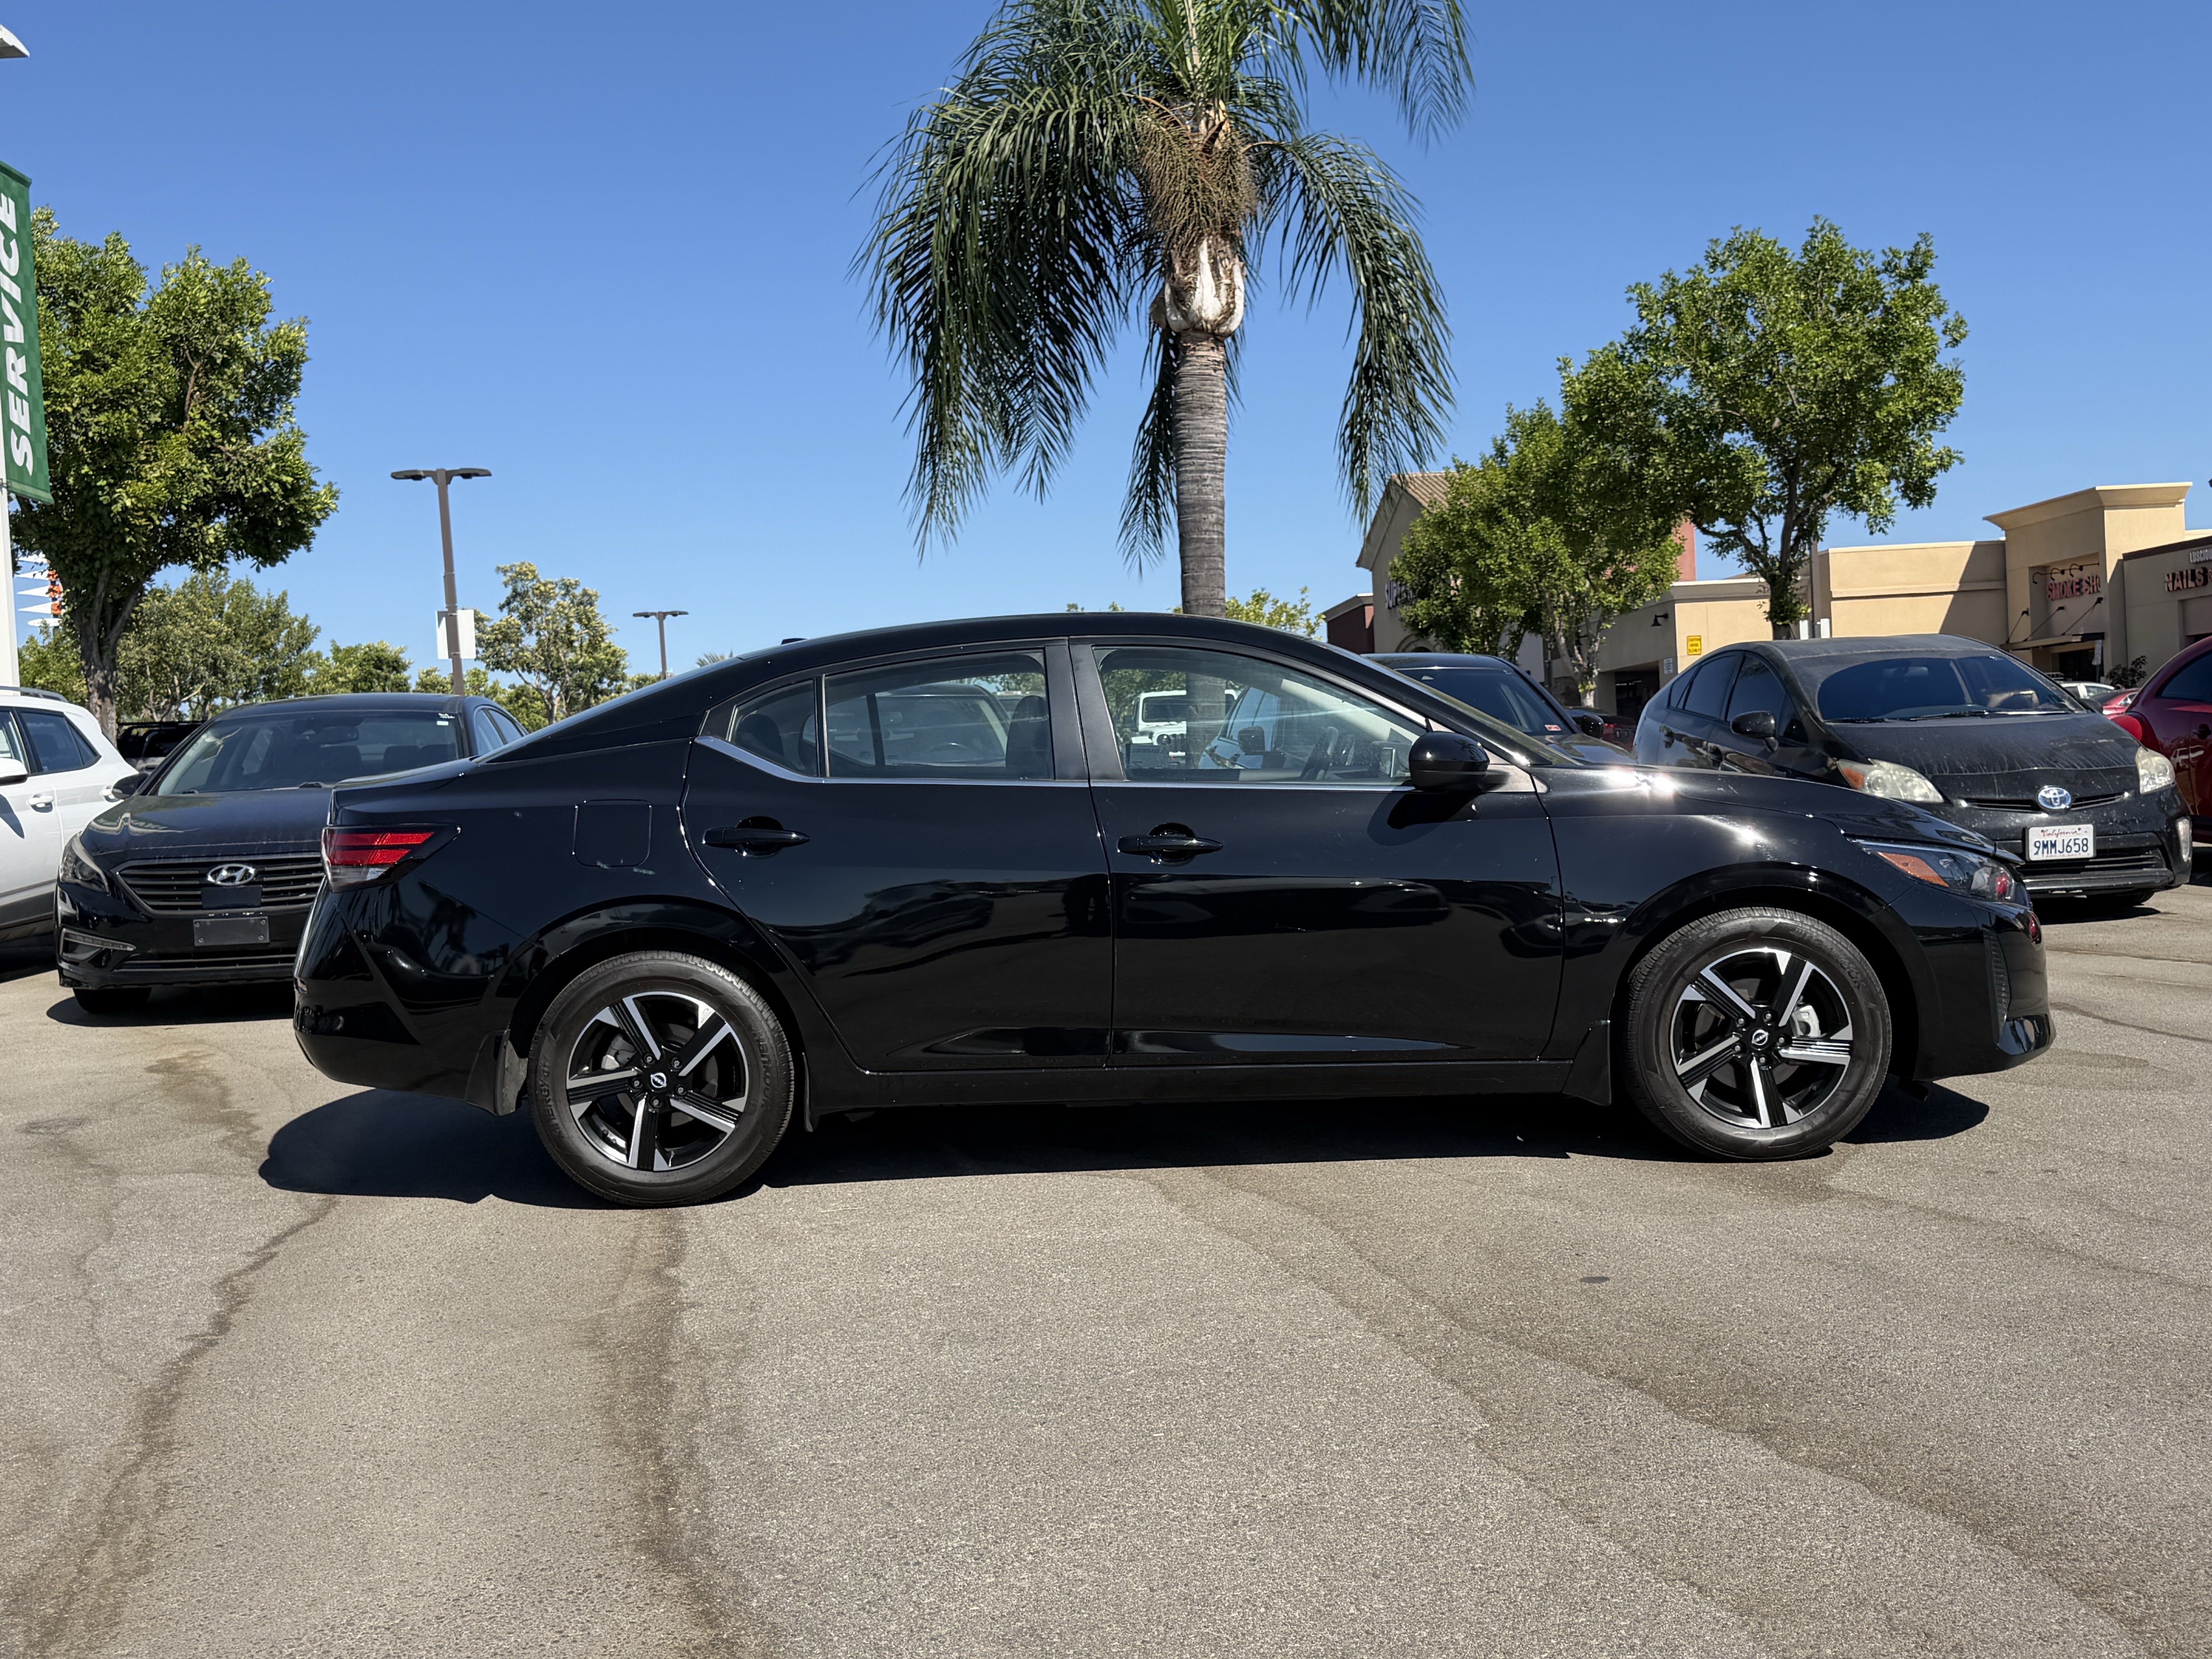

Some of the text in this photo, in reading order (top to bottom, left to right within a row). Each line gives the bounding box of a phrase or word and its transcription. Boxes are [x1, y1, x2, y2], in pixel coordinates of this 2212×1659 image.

[0, 192, 33, 476] SERVICE
[2047, 579, 2081, 601] SMOKE
[2164, 568, 2204, 592] NAILS
[2042, 829, 2080, 838] California
[2033, 838, 2088, 855] 9MMJ658
